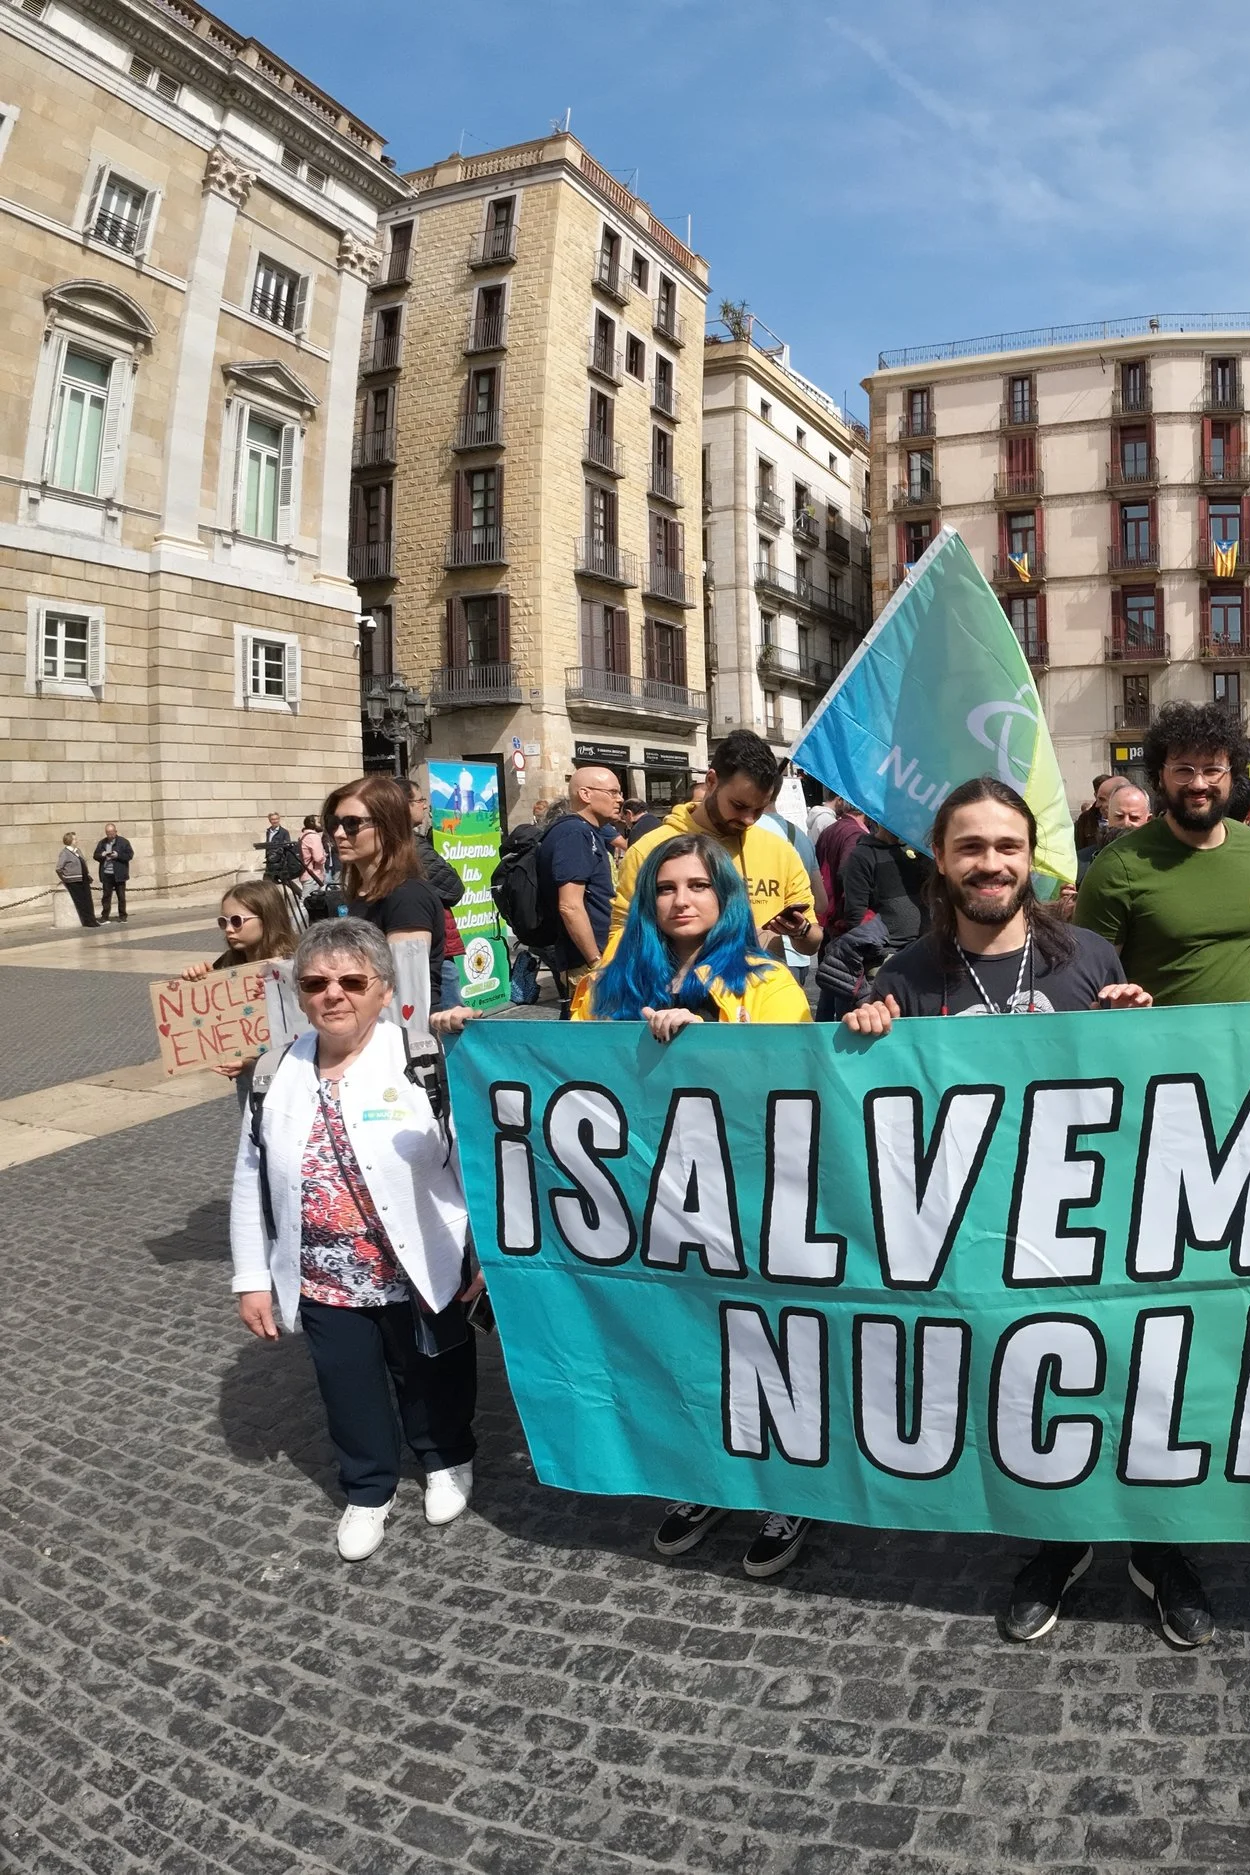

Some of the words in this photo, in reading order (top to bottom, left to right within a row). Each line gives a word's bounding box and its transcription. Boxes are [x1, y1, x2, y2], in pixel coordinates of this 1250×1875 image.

[440, 840, 496, 861] Salvemos
[462, 864, 483, 882] las
[159, 976, 257, 1023] NUCLE
[170, 1016, 270, 1066] ENERG
